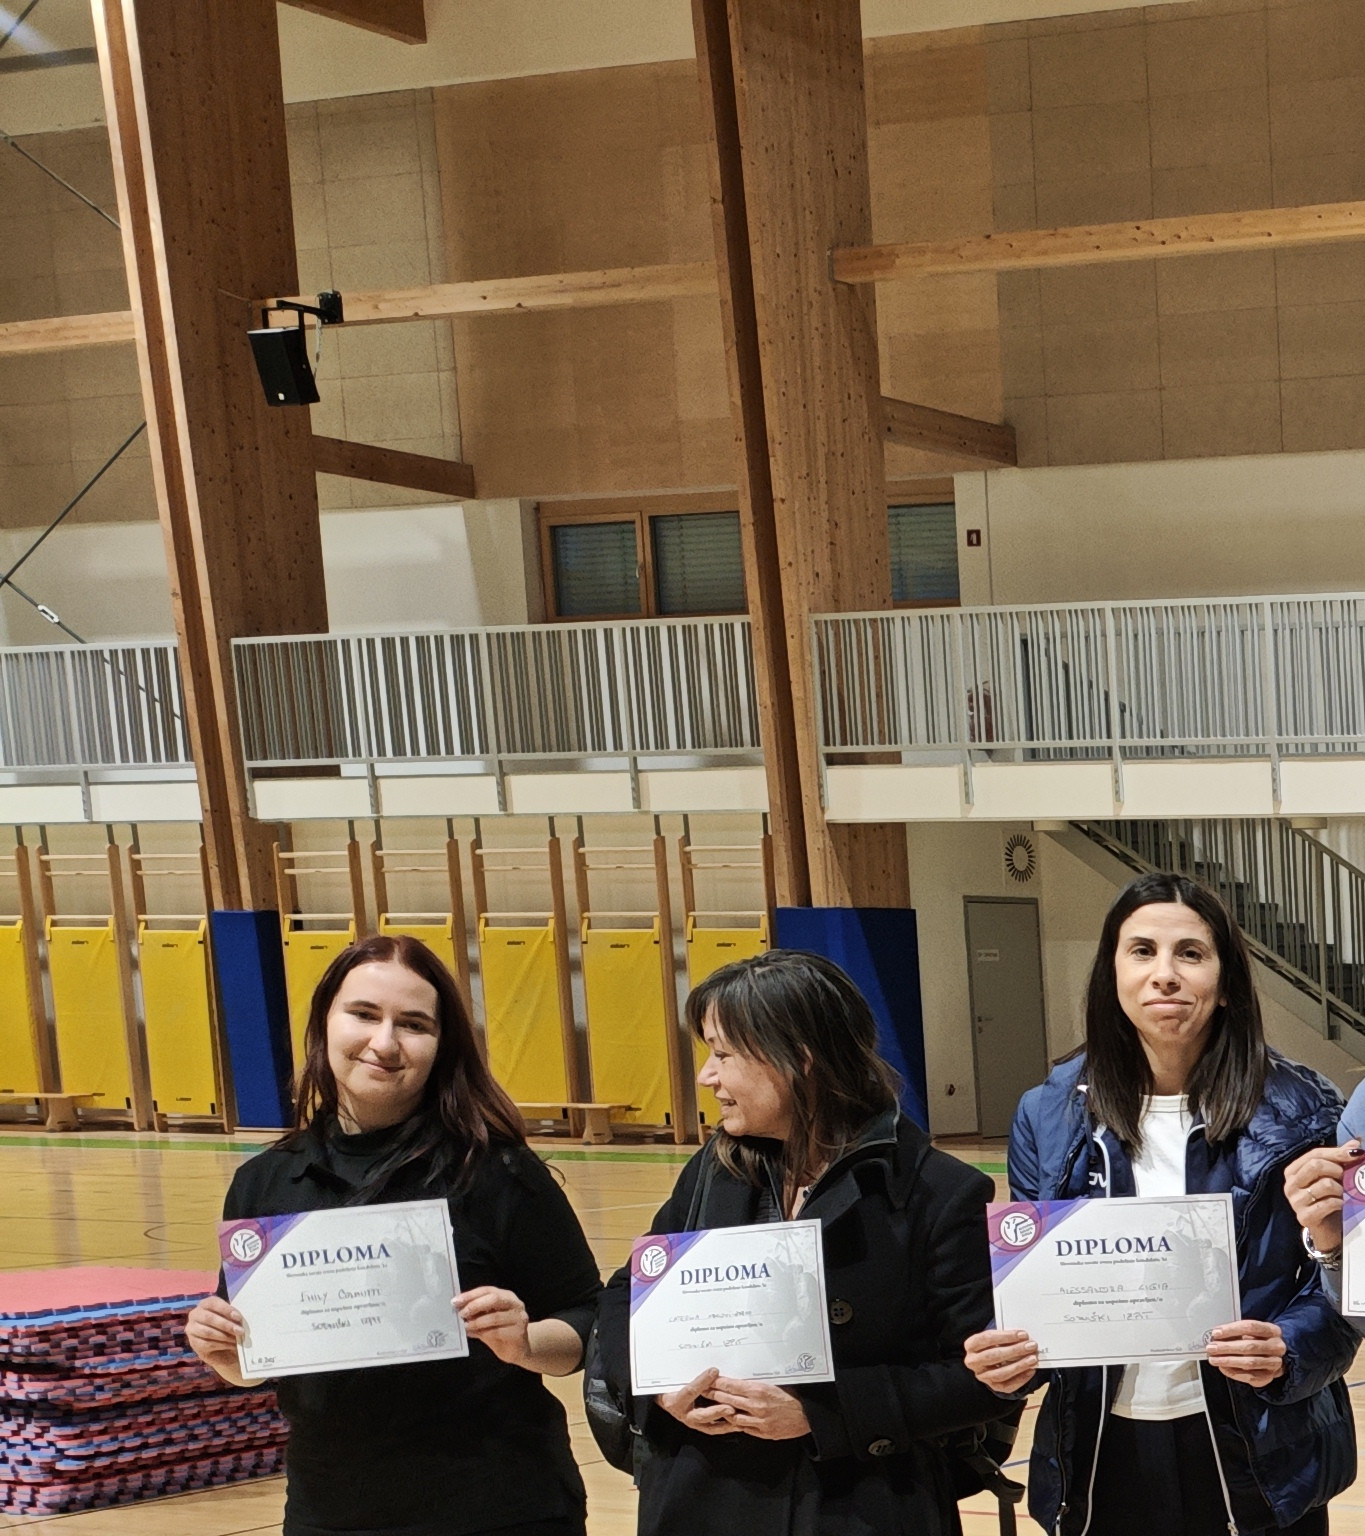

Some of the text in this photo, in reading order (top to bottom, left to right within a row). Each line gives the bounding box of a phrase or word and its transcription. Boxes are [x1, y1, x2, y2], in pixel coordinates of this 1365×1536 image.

[281, 1243, 392, 1269] DIPLOMA
[1055, 1236, 1173, 1257] DIPLOMA
[680, 1262, 772, 1286] DIPLOMA
